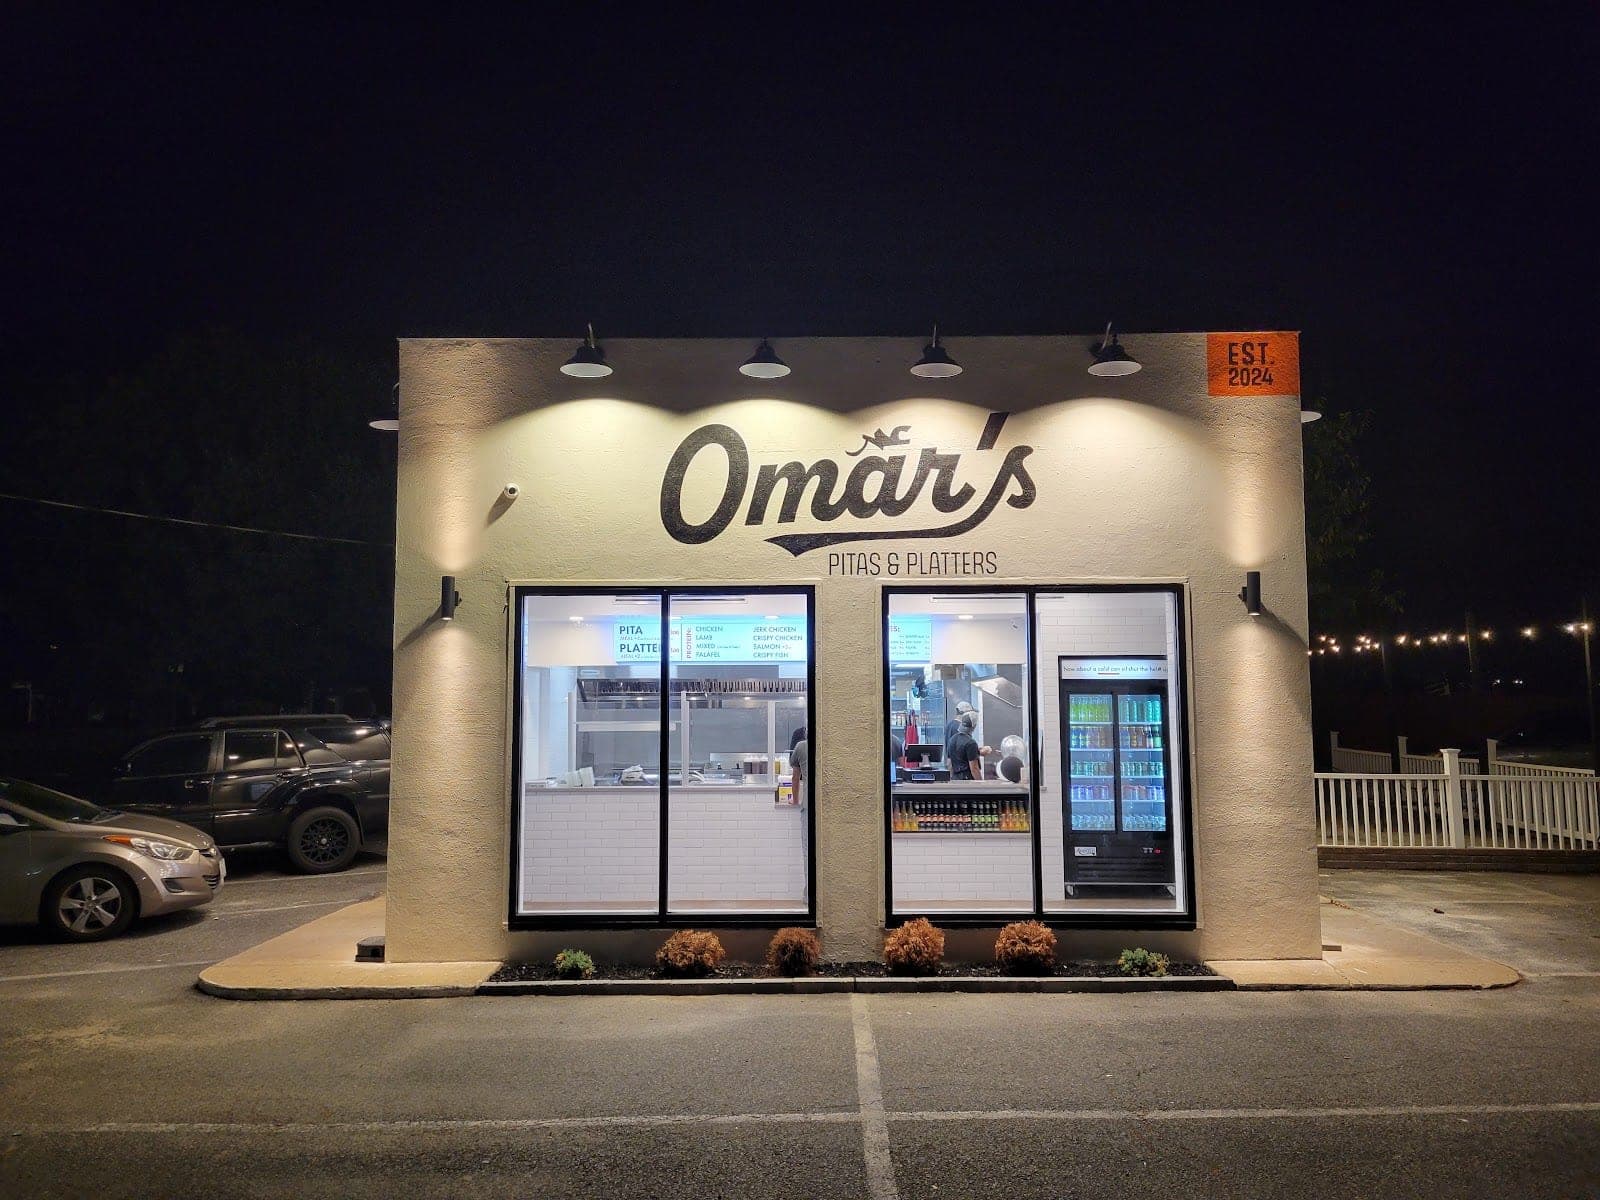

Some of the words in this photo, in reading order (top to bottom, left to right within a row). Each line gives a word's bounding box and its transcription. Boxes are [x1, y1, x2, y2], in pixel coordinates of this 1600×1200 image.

[1228, 341, 1275, 366] EST.
[1228, 367, 1274, 386] 2024
[660, 411, 1037, 557] Omar's
[828, 552, 881, 576] PITAS
[887, 552, 900, 576] &
[907, 551, 997, 575] PLATTERS
[619, 625, 643, 635] PITA
[619, 643, 661, 653] PLATTE
